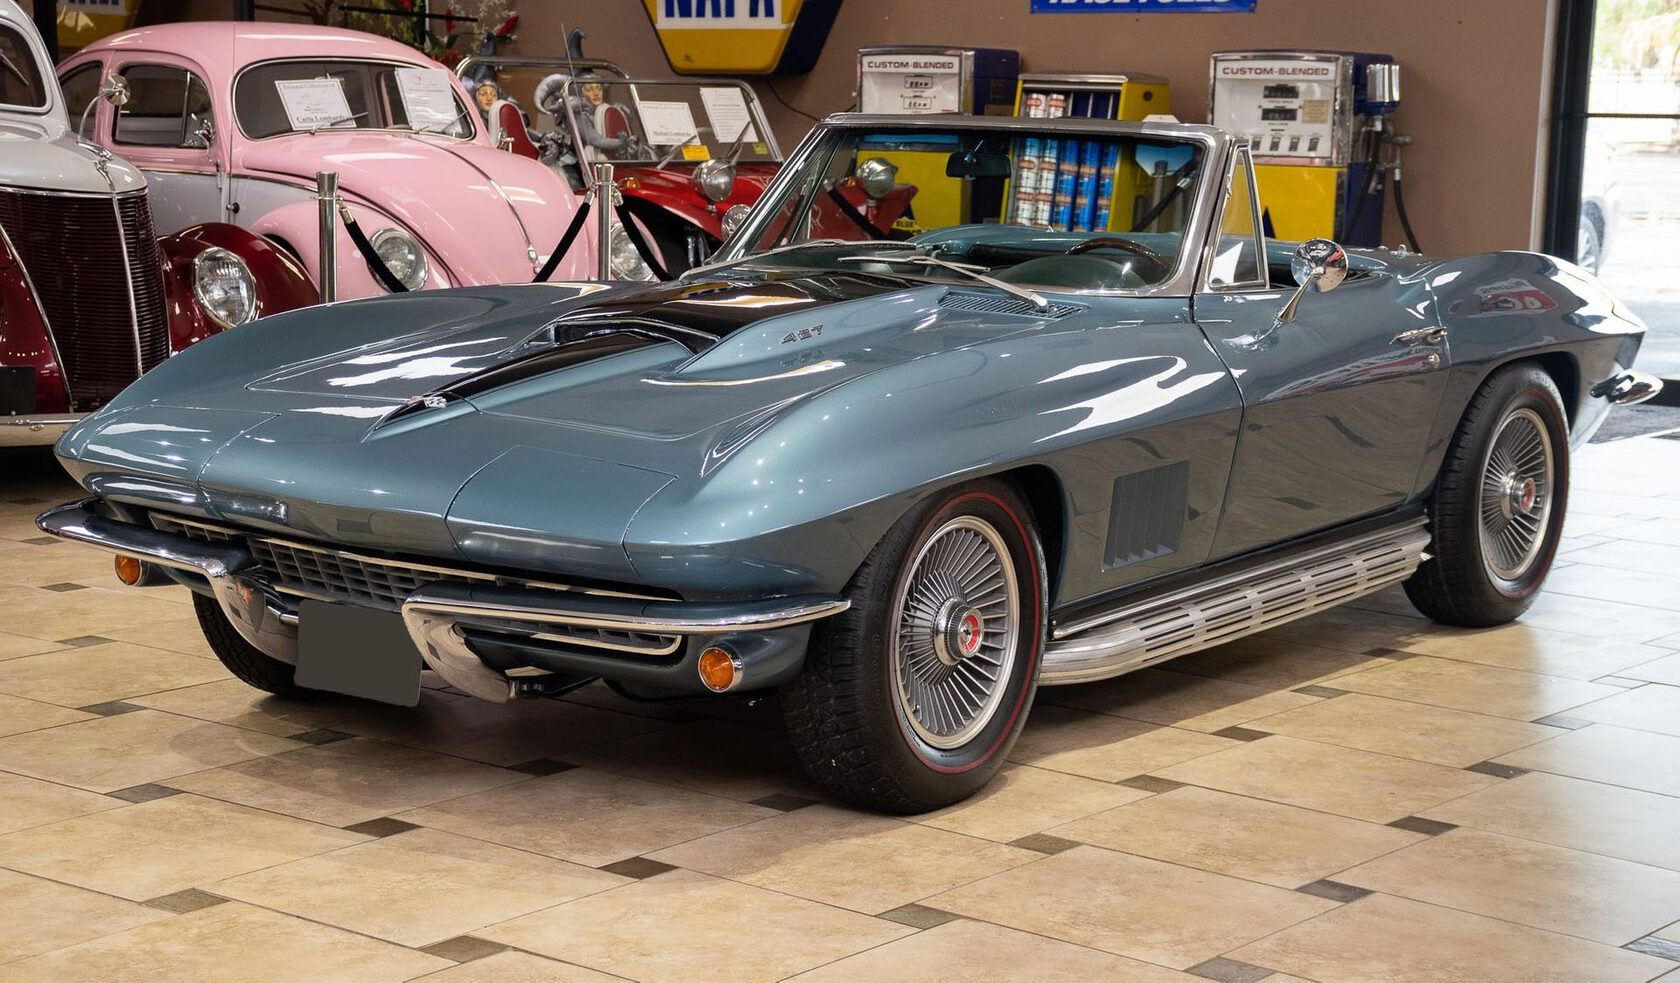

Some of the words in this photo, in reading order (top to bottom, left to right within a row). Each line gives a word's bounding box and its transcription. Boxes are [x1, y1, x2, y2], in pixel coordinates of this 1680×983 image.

[867, 61, 954, 69] CUSTOM-BLENDED
[1222, 67, 1329, 75] CUSTOM-BLENDED
[781, 324, 824, 344] 427
